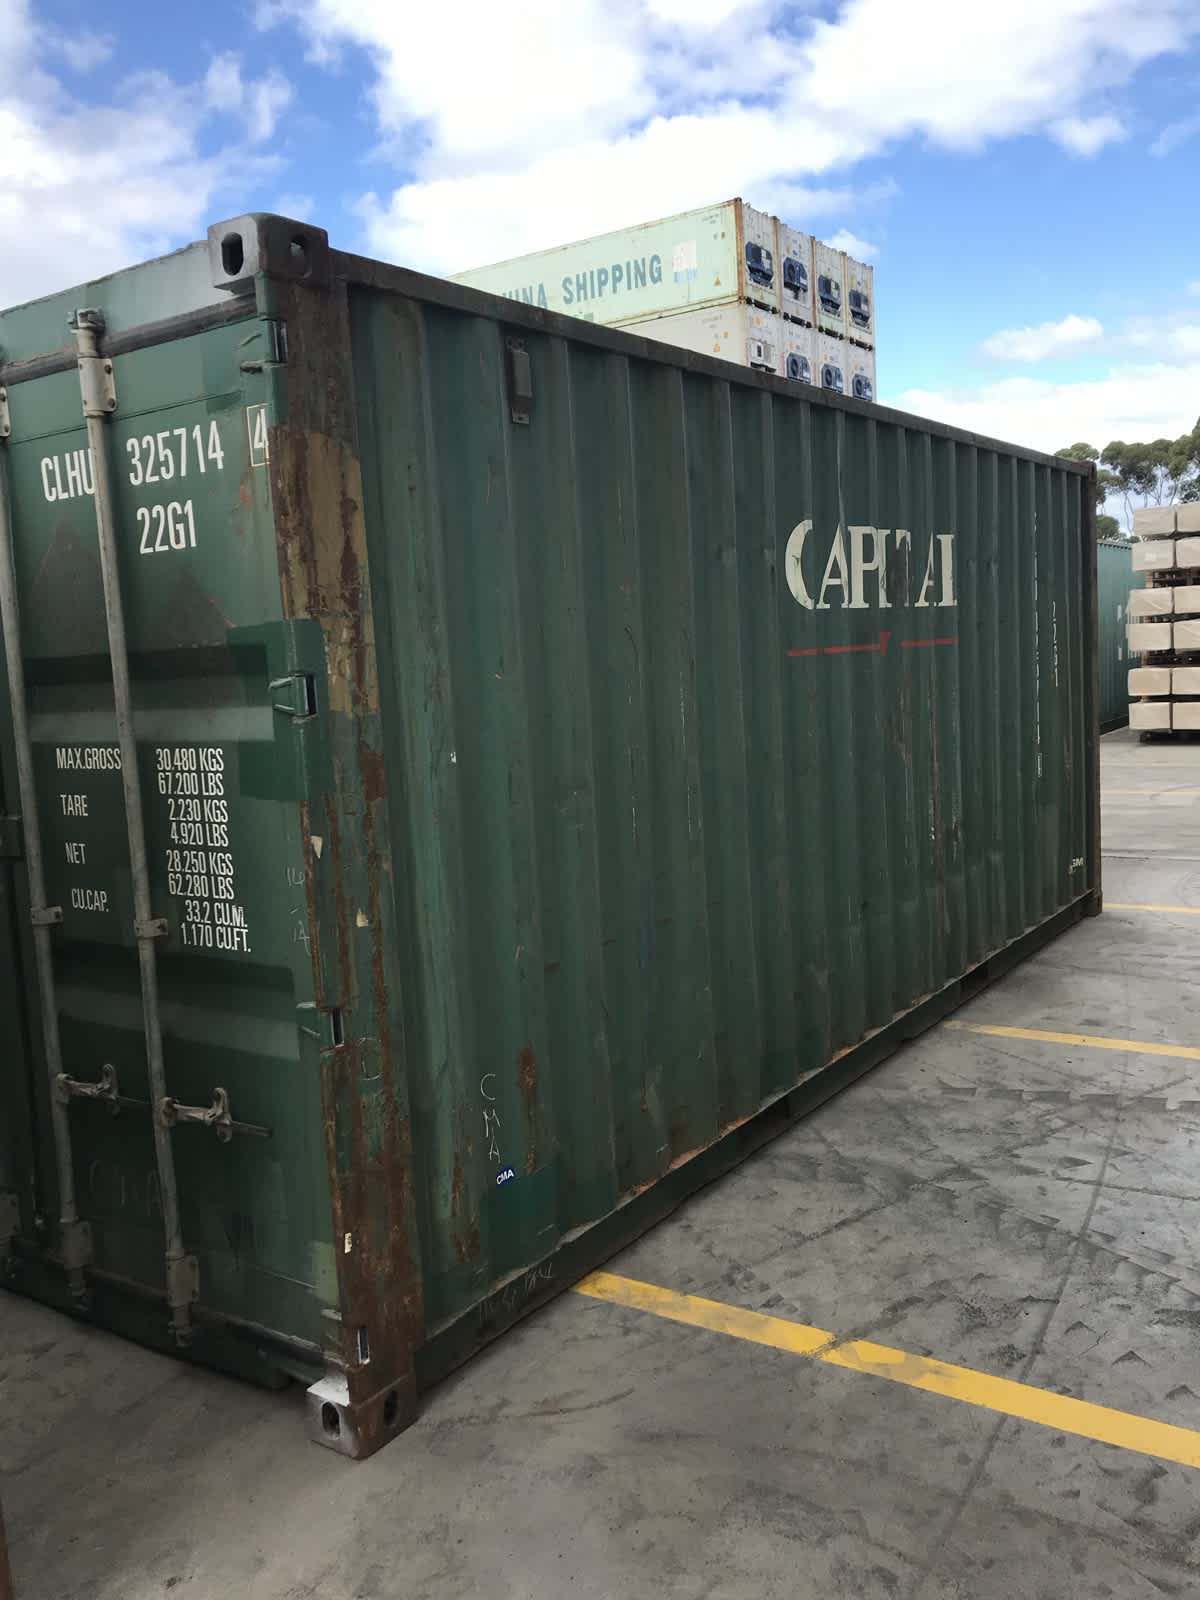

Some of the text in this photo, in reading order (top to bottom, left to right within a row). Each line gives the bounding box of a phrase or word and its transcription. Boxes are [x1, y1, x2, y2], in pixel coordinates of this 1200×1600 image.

[562, 254, 663, 305] SHIPPING
[41, 408, 269, 501] CLHU 325714 4
[136, 500, 197, 554] 22G1
[56, 748, 224, 771] MAX.GROSS 30.480 KGS
[158, 772, 224, 796] 67.200 LBS
[60, 794, 228, 823] TARE 2.230 KGS
[171, 823, 229, 847] 4.920 LBS
[65, 843, 234, 876] NET 28.250 KGS
[168, 873, 234, 900] 62.280 LBS
[71, 888, 248, 928] CU.CAP. 33.2 CU.M.
[181, 923, 251, 952] 1.170 CU.FT.
[496, 1169, 515, 1185] CMA
